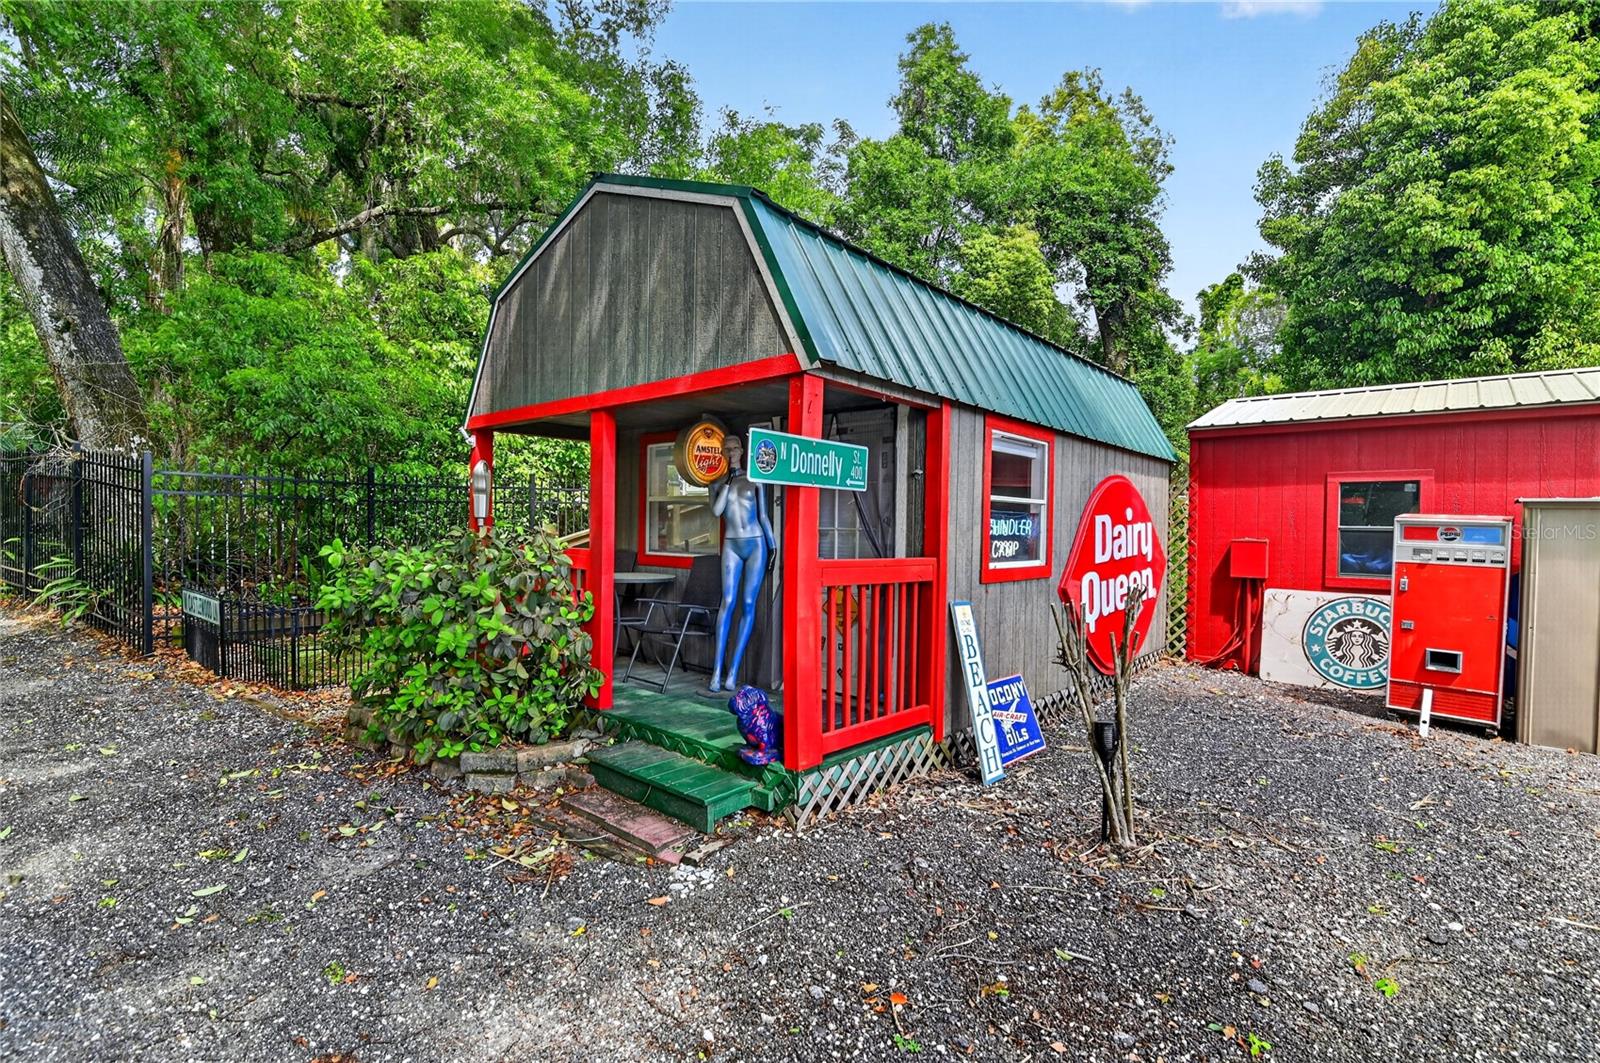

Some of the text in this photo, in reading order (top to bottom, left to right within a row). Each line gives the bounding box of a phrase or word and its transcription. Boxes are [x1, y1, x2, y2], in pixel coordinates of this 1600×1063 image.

[696, 444, 722, 455] AMSTEL
[781, 442, 842, 485] N Donnelly
[851, 465, 863, 480] 400
[1094, 507, 1152, 564] Dairy
[1081, 567, 1157, 633] Queen
[1309, 601, 1391, 637] STARBUC
[964, 634, 1000, 775] BEACH
[988, 681, 1025, 706] OCONY
[1006, 728, 1029, 746] OILS
